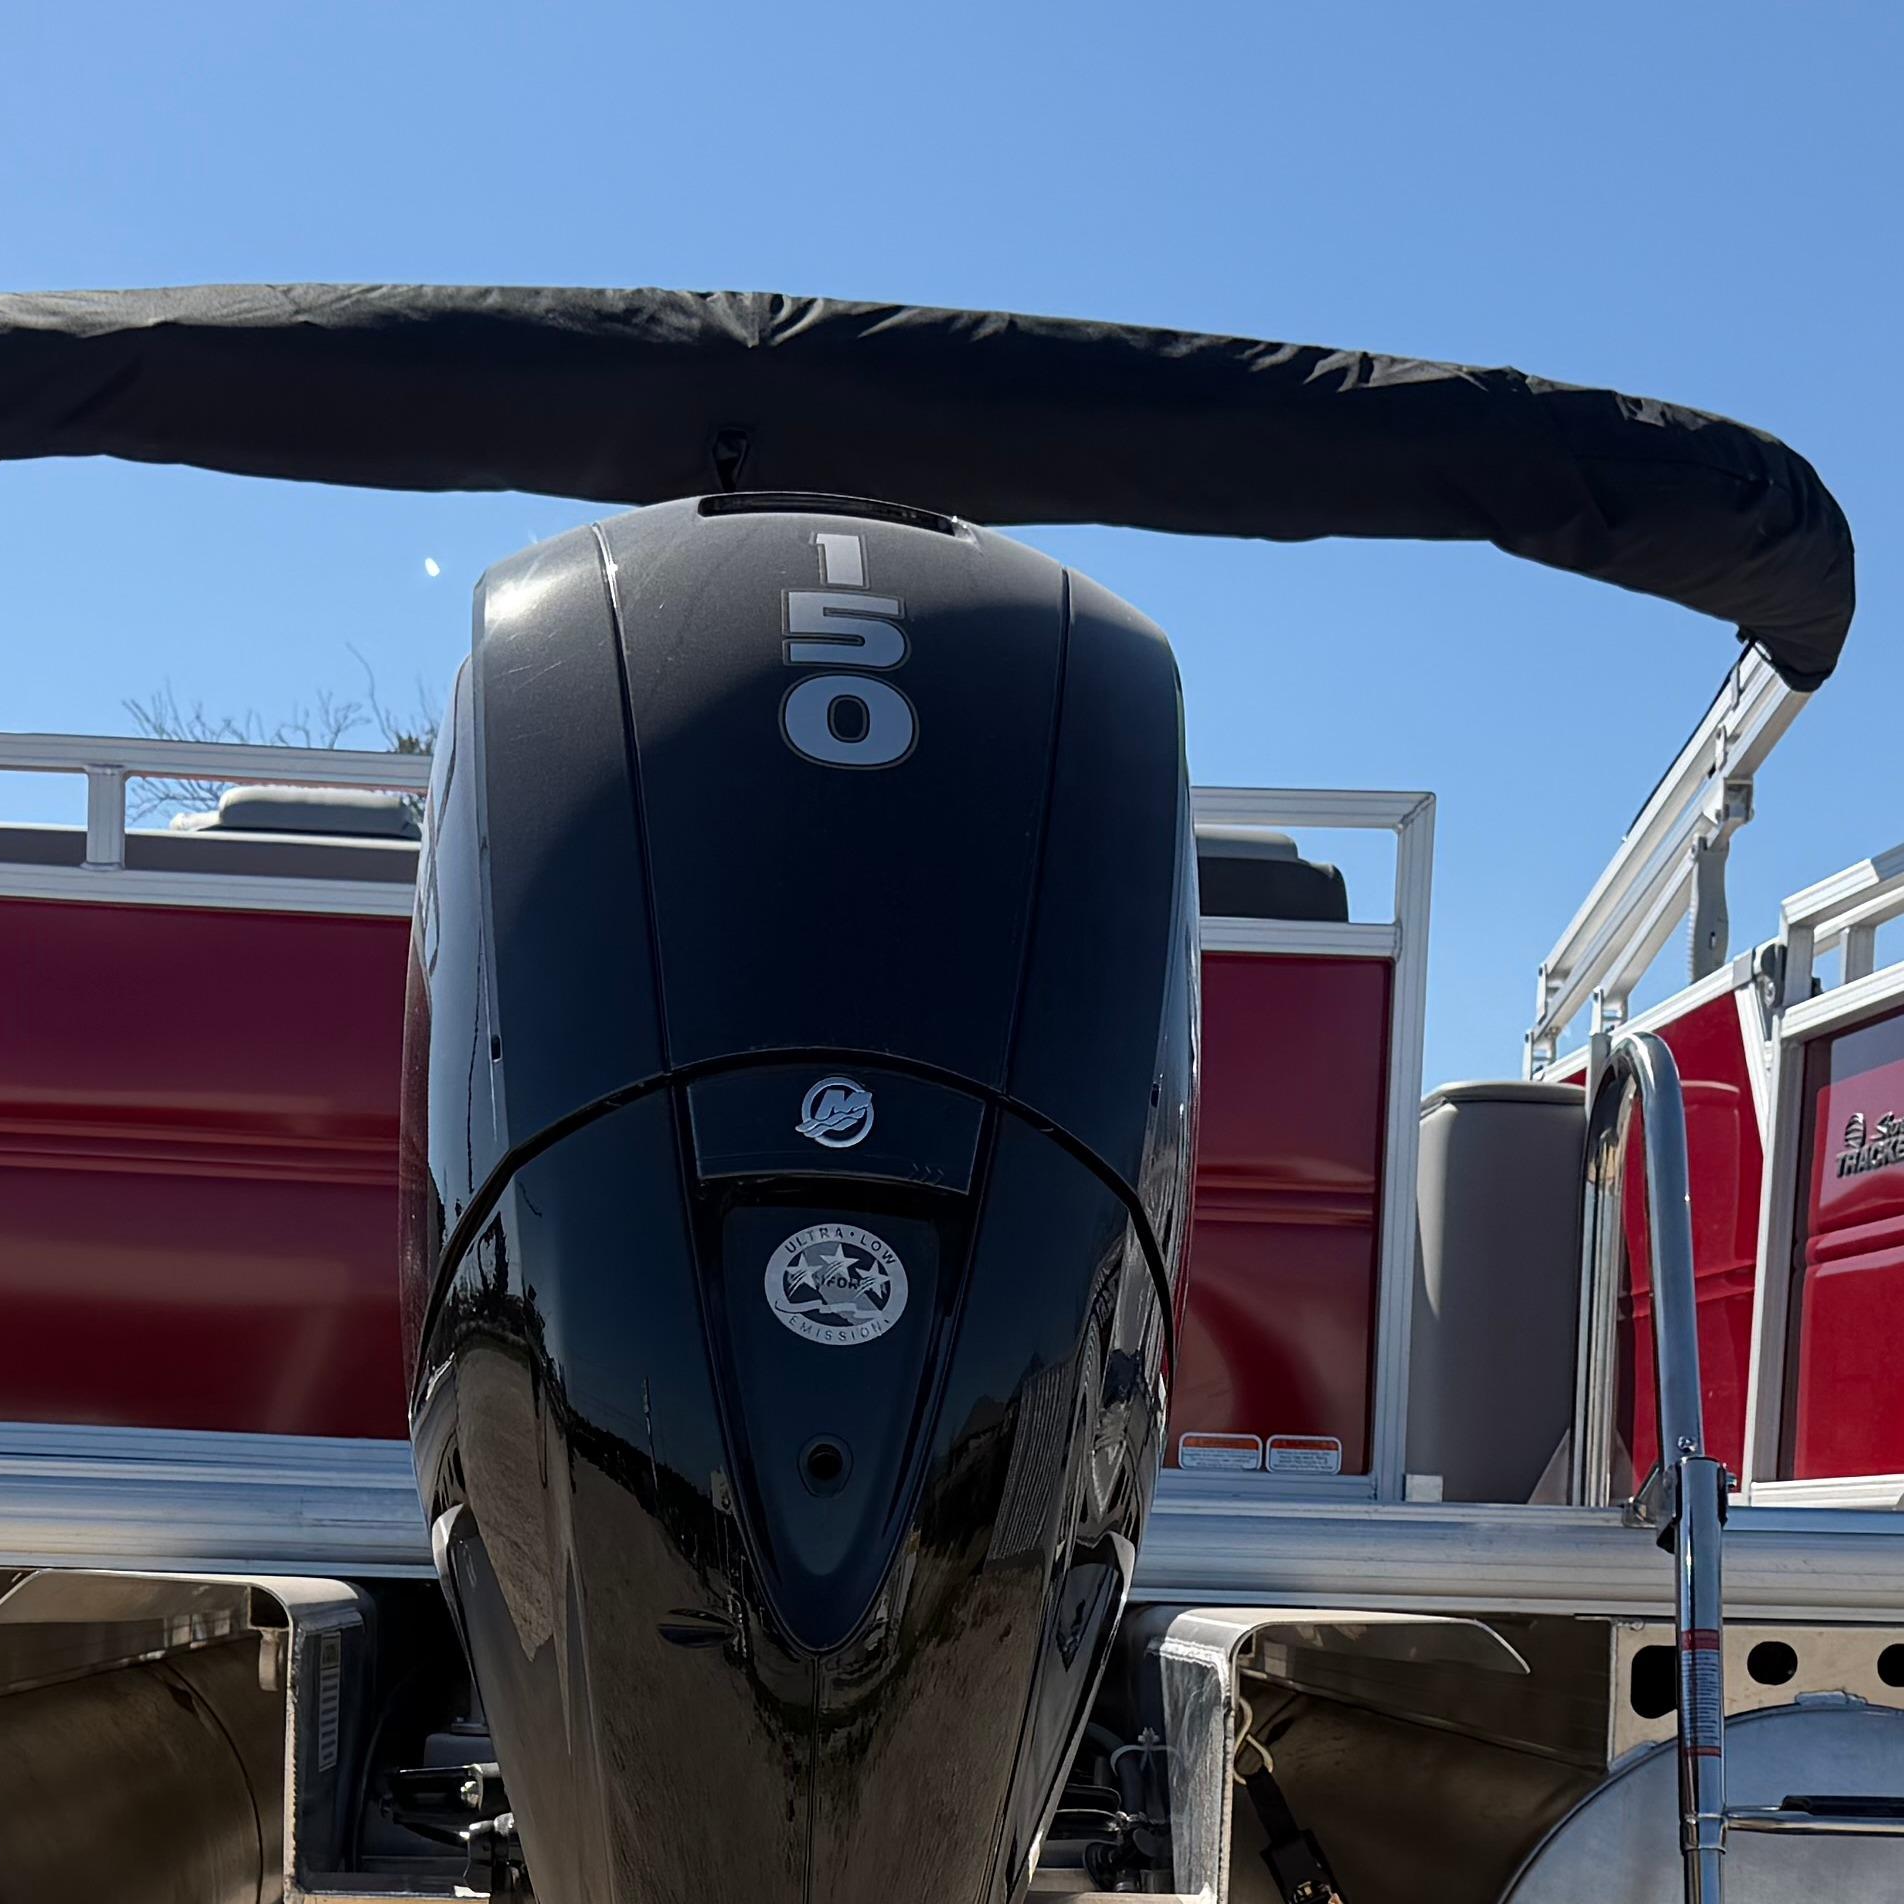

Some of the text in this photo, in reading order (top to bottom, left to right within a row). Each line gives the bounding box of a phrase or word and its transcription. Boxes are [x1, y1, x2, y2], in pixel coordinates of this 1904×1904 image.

[782, 532, 916, 768] 150
[784, 1227, 896, 1265] ULTRA LOW
[788, 1315, 883, 1341] EMISSION
